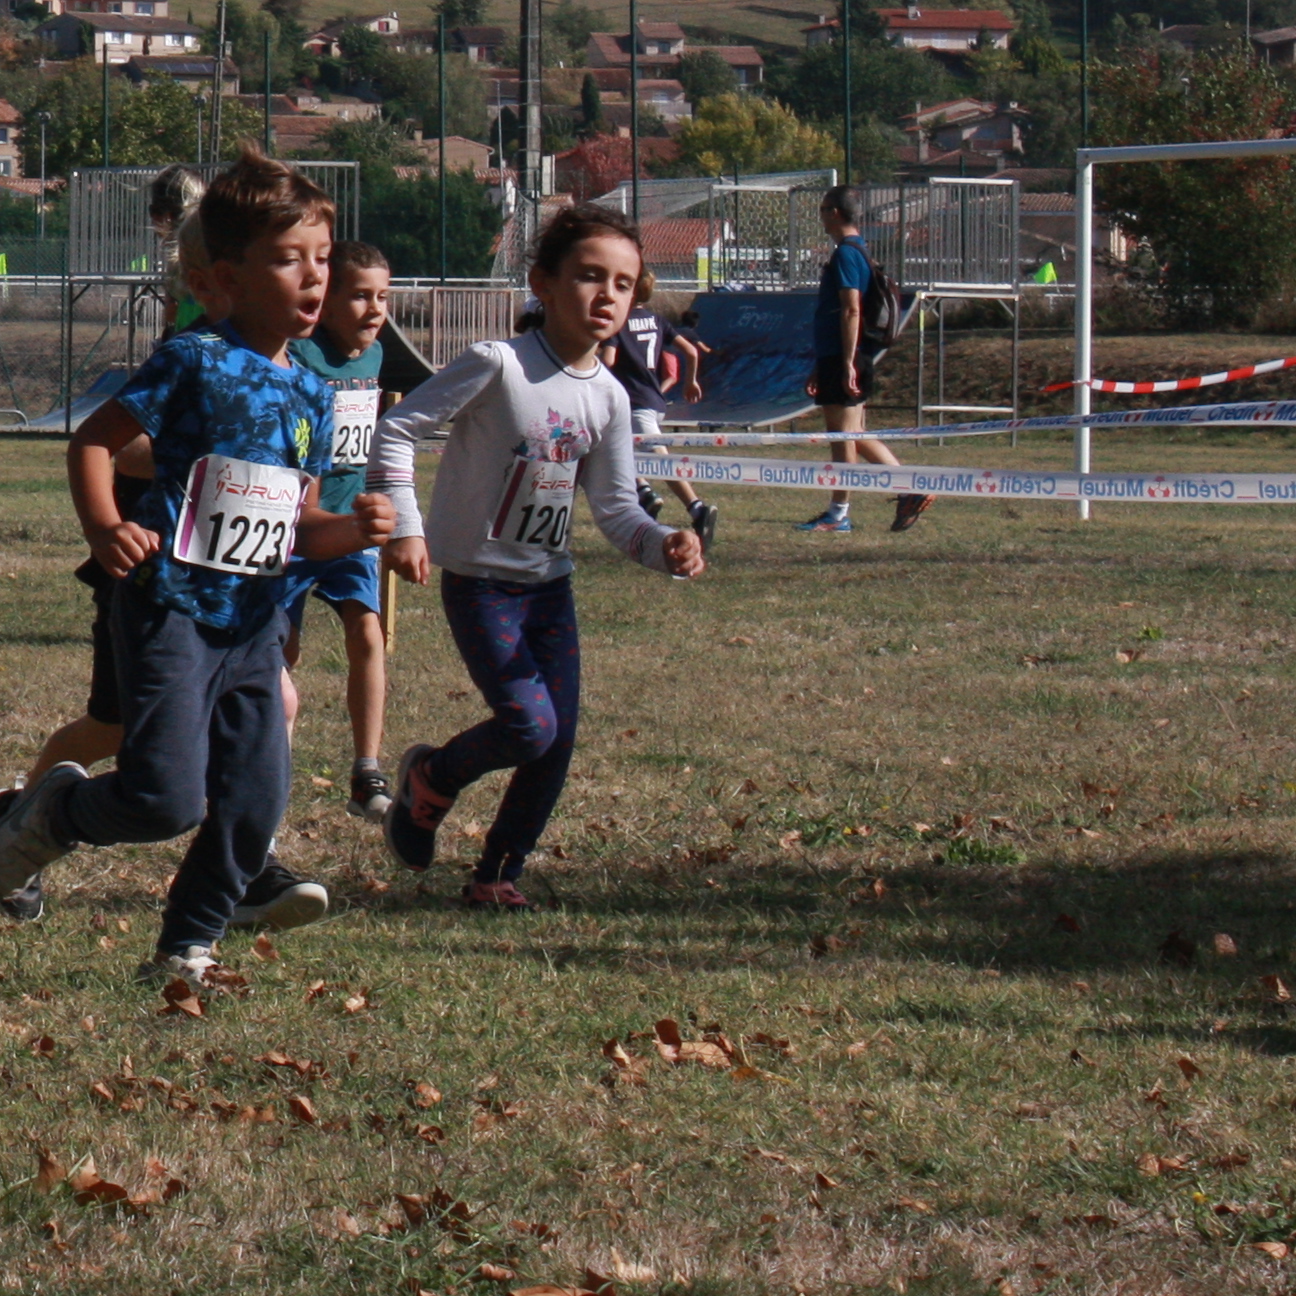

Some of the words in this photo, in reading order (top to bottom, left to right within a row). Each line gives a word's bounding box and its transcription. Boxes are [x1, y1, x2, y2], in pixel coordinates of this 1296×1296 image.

[637, 332, 657, 369] 7
[334, 425, 372, 458] 230
[206, 511, 286, 570] 1223
[515, 504, 568, 547] 120
